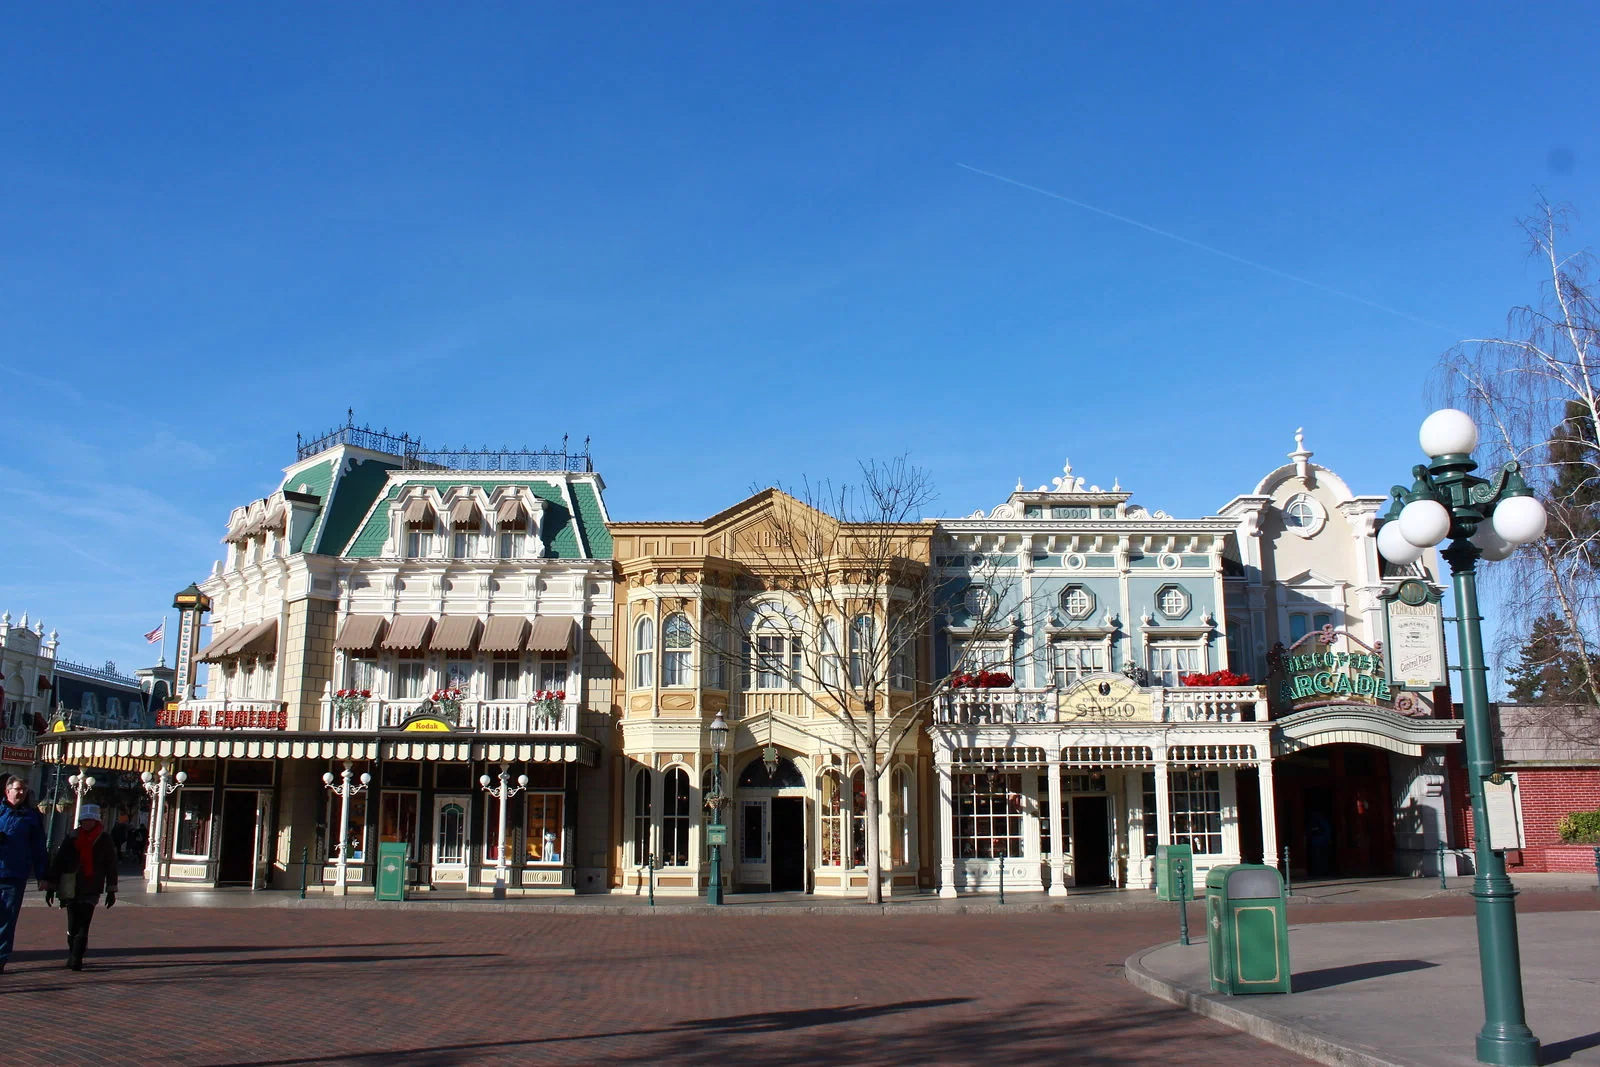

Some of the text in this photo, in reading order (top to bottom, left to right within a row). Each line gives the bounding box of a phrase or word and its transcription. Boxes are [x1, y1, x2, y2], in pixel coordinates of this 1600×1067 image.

[1055, 508, 1088, 519] 1900
[1282, 651, 1380, 674] DISCOVERY
[1280, 671, 1392, 701] ARCADE
[156, 710, 288, 730] FILM & CAMERAS
[1076, 703, 1135, 717] STUDIO
